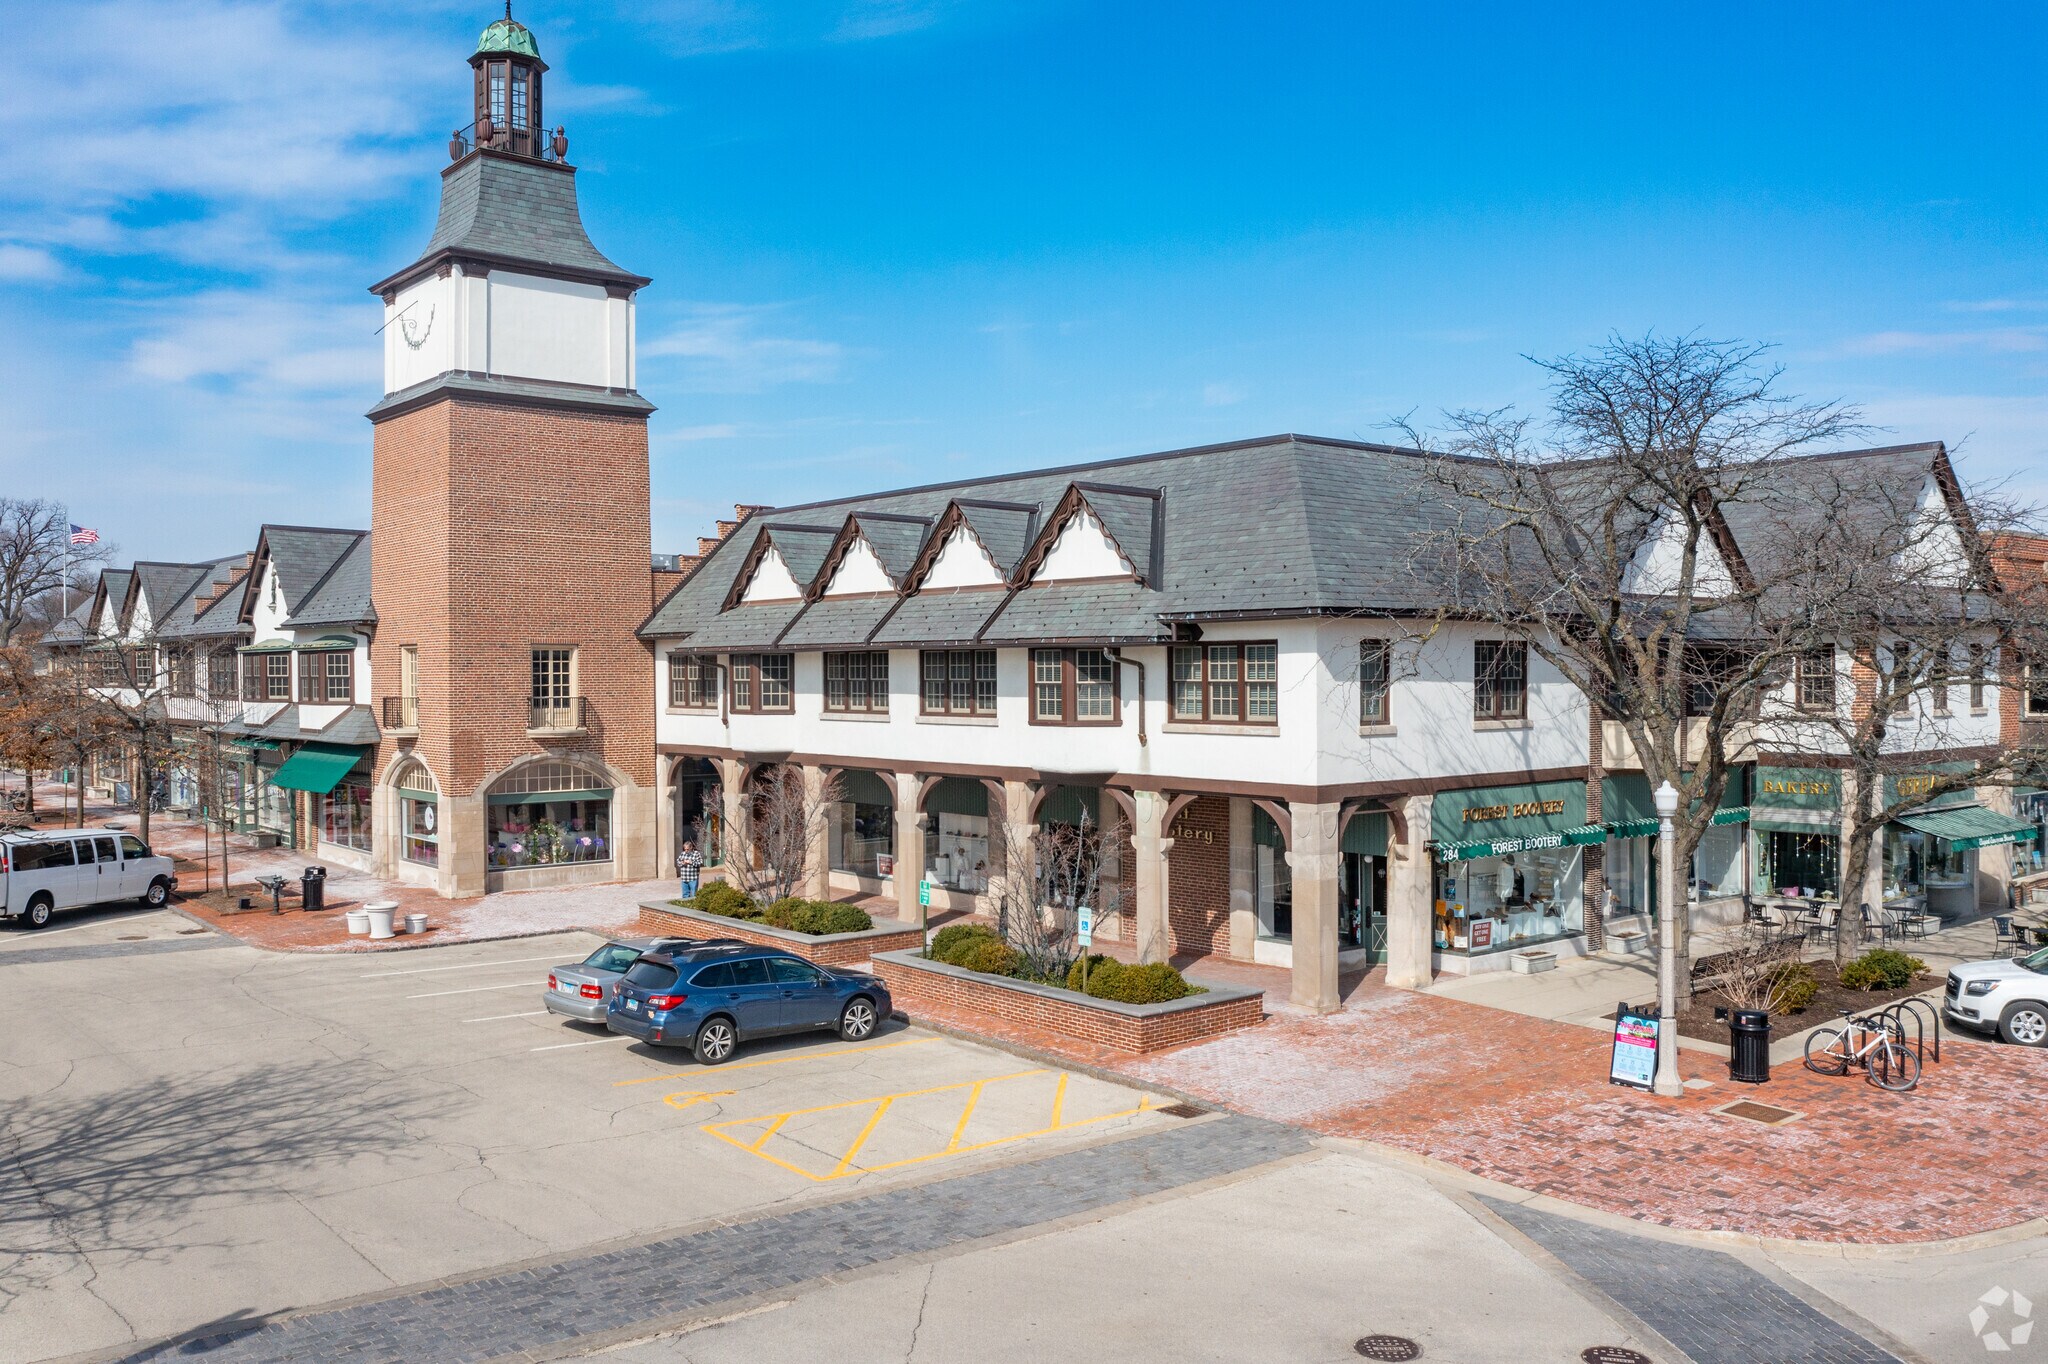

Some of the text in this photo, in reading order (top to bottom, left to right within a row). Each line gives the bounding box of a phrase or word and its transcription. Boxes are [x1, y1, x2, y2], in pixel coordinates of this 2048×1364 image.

[1763, 780, 1832, 795] BAKERY
[1462, 800, 1564, 821] FOREST BOOTERY
[1492, 835, 1562, 854] FOREST BOOTERY
[1443, 848, 1459, 861] 284
